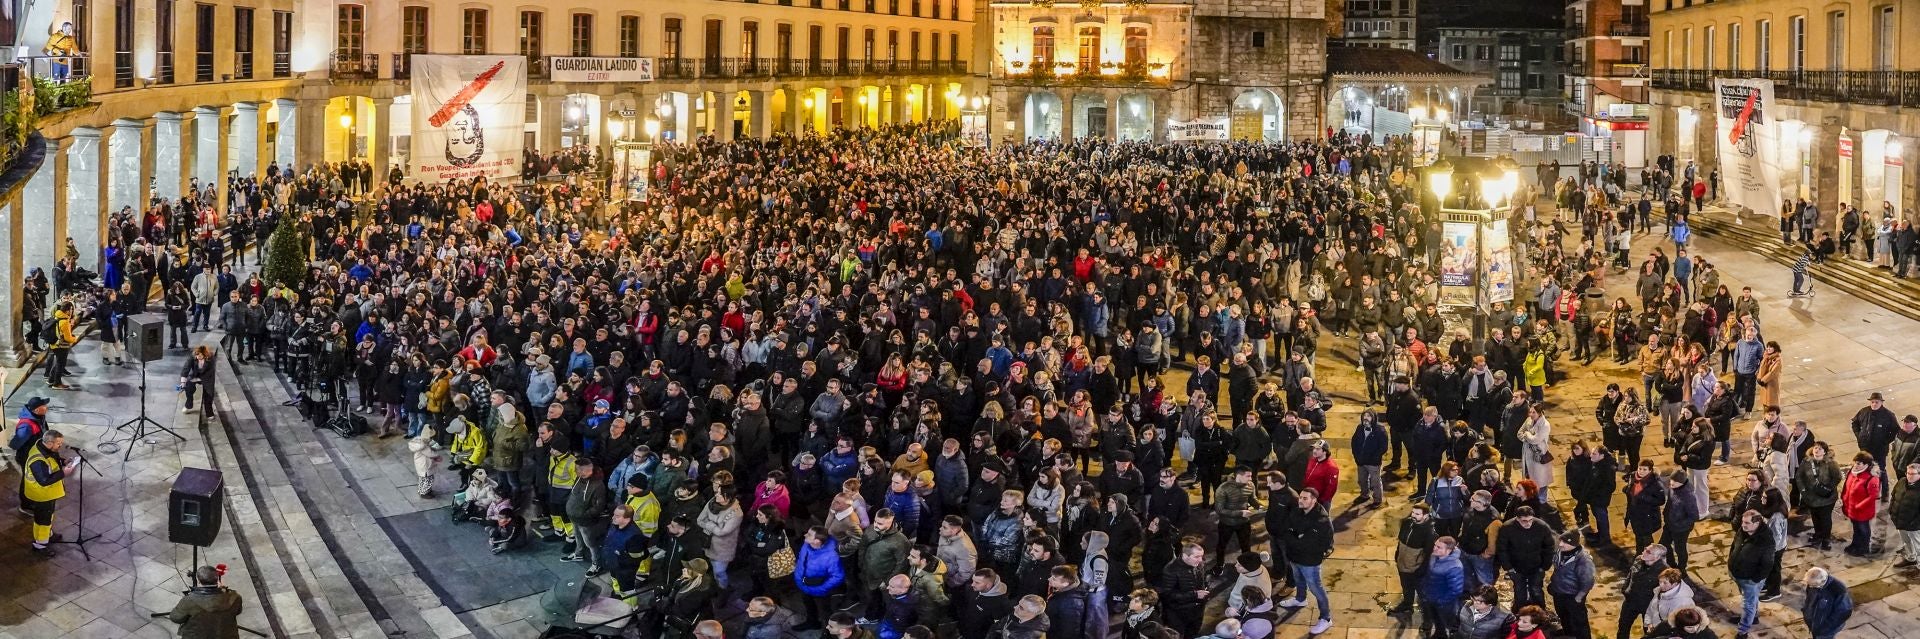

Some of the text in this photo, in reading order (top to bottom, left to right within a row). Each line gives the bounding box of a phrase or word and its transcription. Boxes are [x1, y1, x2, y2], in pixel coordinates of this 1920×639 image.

[555, 58, 637, 71] GUARDIAN LAUDIO
[587, 72, 595, 80] EZ
[421, 165, 435, 173] Ron
[503, 158, 514, 166] CEO
[439, 171, 469, 179] Guardian
